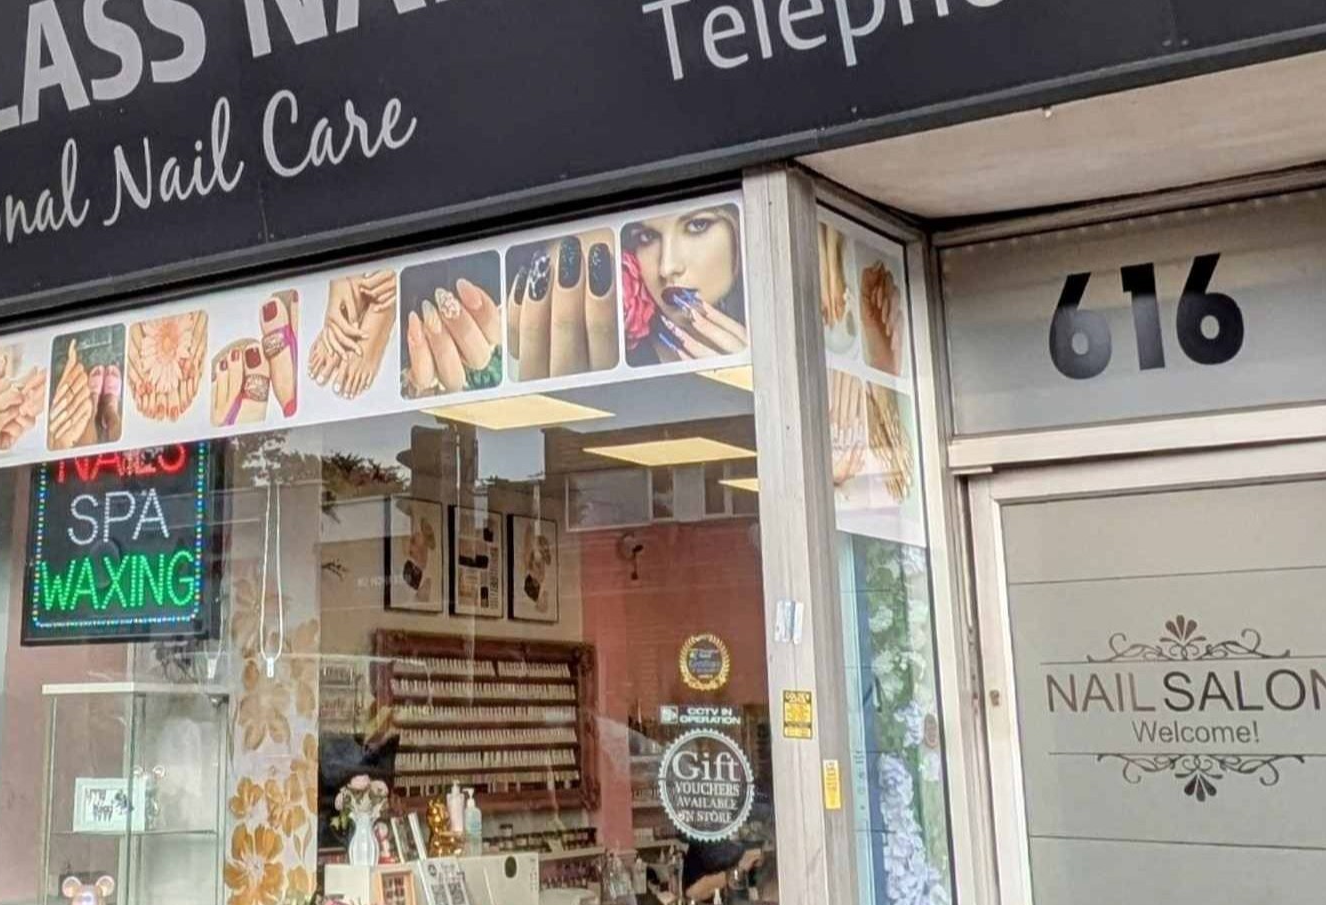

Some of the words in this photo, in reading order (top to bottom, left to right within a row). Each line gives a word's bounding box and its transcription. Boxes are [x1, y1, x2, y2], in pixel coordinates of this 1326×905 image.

[103, 97, 244, 226] Nail
[263, 90, 417, 177] Care
[1049, 253, 1244, 380] 616
[68, 487, 171, 545] SPA
[41, 550, 195, 611] WAXING
[680, 715, 742, 725] OPERATION
[687, 707, 719, 717] CCTV
[721, 707, 733, 717] IN
[1132, 719, 1260, 744] Welcome!
[673, 750, 742, 782] Gift
[675, 782, 741, 796] VOUCHERS
[676, 796, 739, 811] AVAILABLE
[697, 810, 734, 823] STORE
